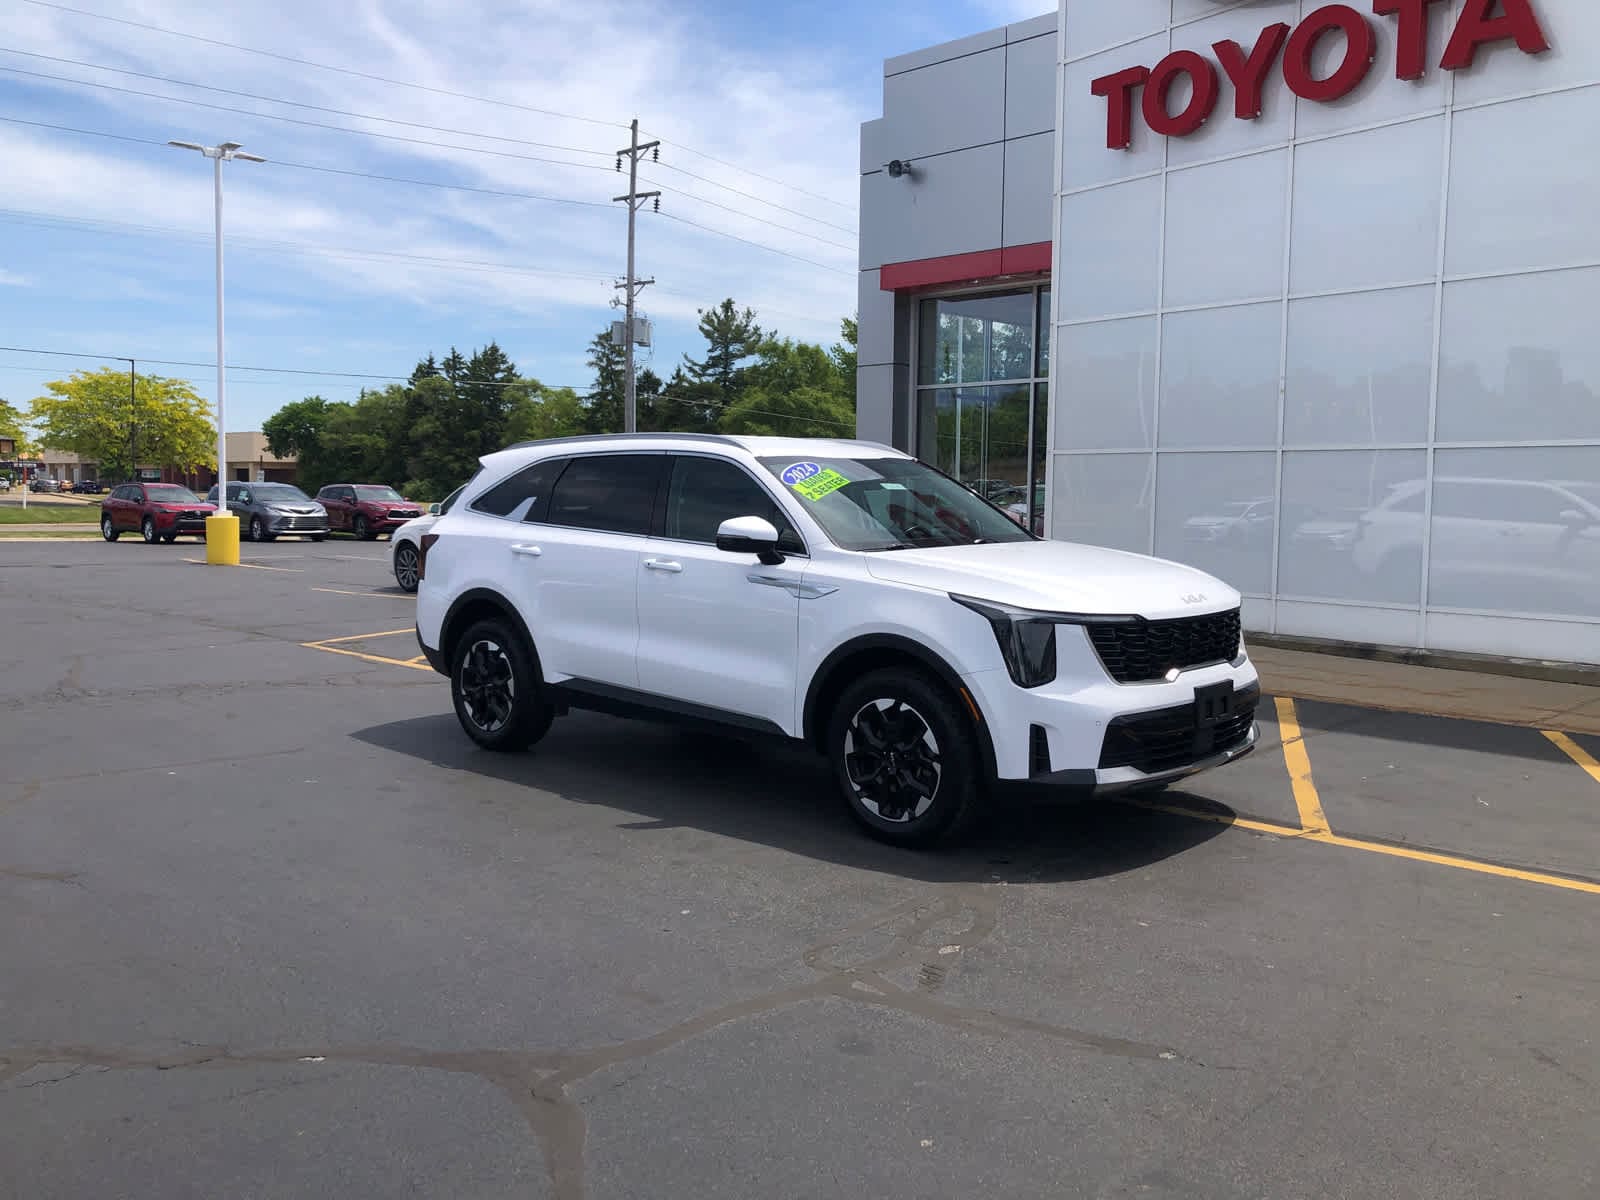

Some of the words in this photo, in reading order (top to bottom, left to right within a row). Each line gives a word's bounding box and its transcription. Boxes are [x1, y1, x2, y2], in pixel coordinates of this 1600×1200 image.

[1092, 0, 1549, 149] TOYOTA
[786, 463, 816, 483] 2024
[812, 476, 846, 496] SEATER
